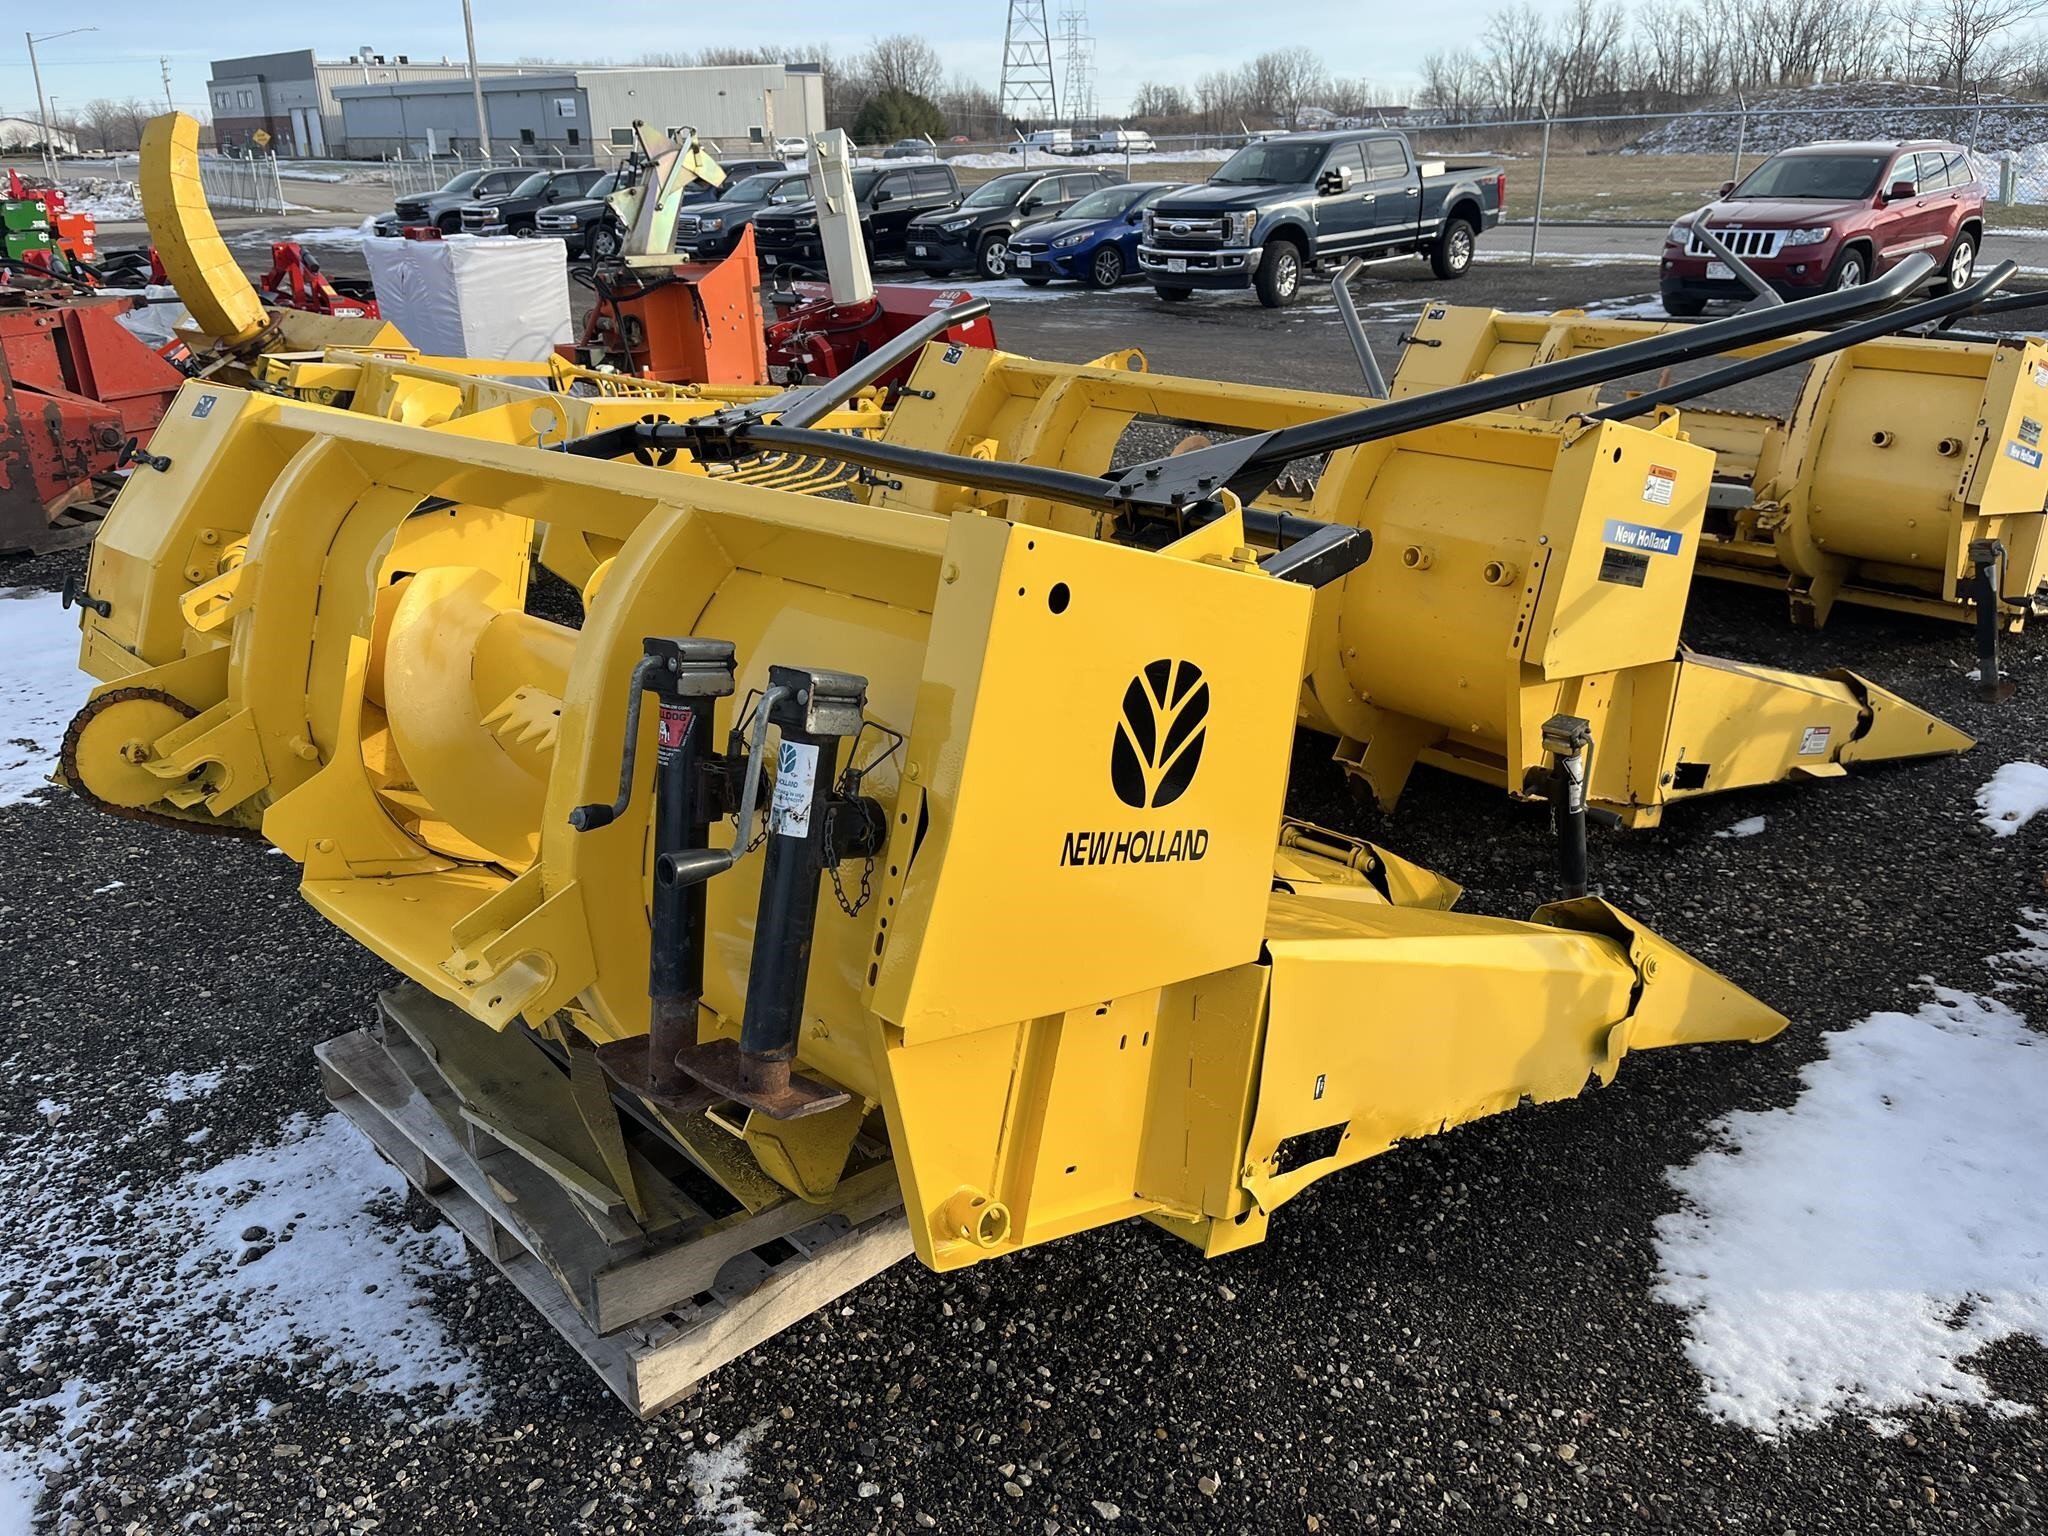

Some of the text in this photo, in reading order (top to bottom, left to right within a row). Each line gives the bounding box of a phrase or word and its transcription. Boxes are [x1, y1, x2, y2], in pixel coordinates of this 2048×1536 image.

[1615, 525, 1671, 551] New Holland
[1060, 829, 1209, 866] NEW HOLLAND
